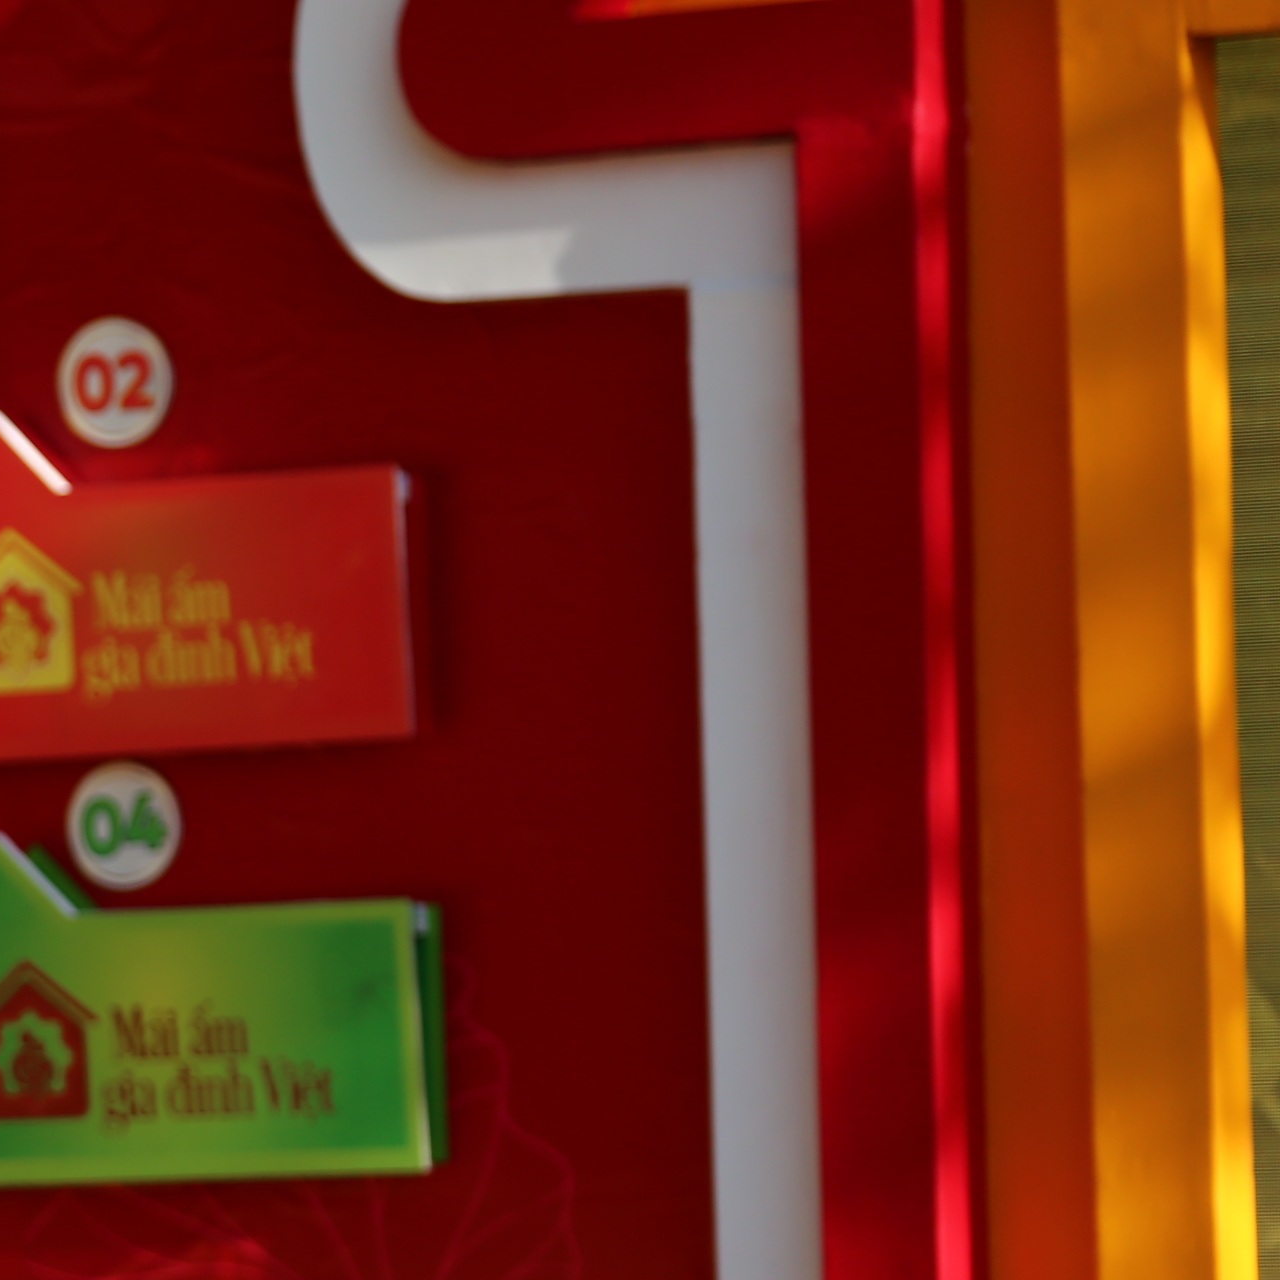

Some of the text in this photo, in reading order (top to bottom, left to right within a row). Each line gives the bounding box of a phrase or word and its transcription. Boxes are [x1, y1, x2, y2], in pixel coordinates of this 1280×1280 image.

[75, 352, 157, 414] 02
[93, 562, 232, 634] Mái ấm
[82, 617, 315, 705] gia đình Việt
[82, 788, 168, 858] 04
[109, 996, 249, 1060] Mái ấm
[100, 1054, 335, 1136] gia đình Việt
